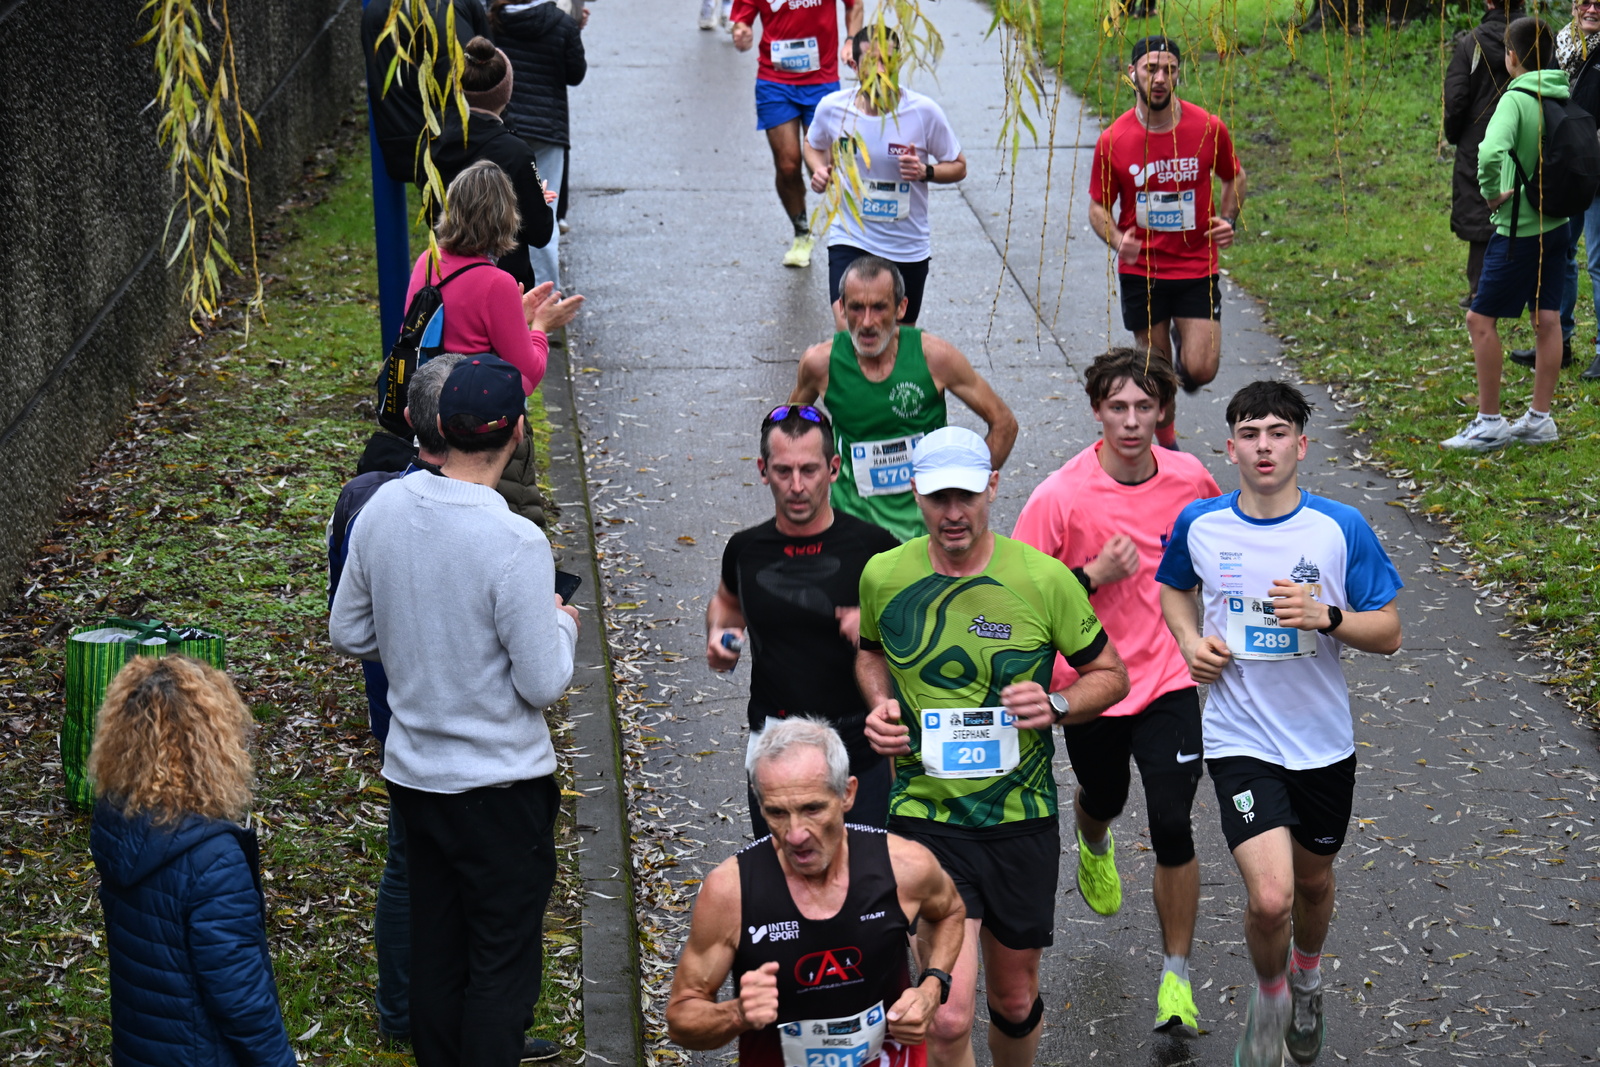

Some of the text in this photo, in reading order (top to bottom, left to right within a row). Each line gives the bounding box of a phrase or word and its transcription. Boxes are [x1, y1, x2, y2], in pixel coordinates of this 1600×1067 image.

[782, 57, 809, 68] 3087
[1155, 157, 1199, 172] INTER
[1157, 170, 1199, 183] SPORT
[864, 200, 897, 214] 2642
[1149, 213, 1182, 224] 3082
[877, 466, 910, 484] 570
[1263, 617, 1278, 626] TOM
[1252, 631, 1291, 648] 289
[953, 729, 990, 739] STEPHANE
[957, 747, 986, 764] 20
[1242, 812, 1255, 824] TP
[859, 911, 886, 921] START
[768, 921, 799, 932] INTER
[769, 930, 800, 942] SPORT
